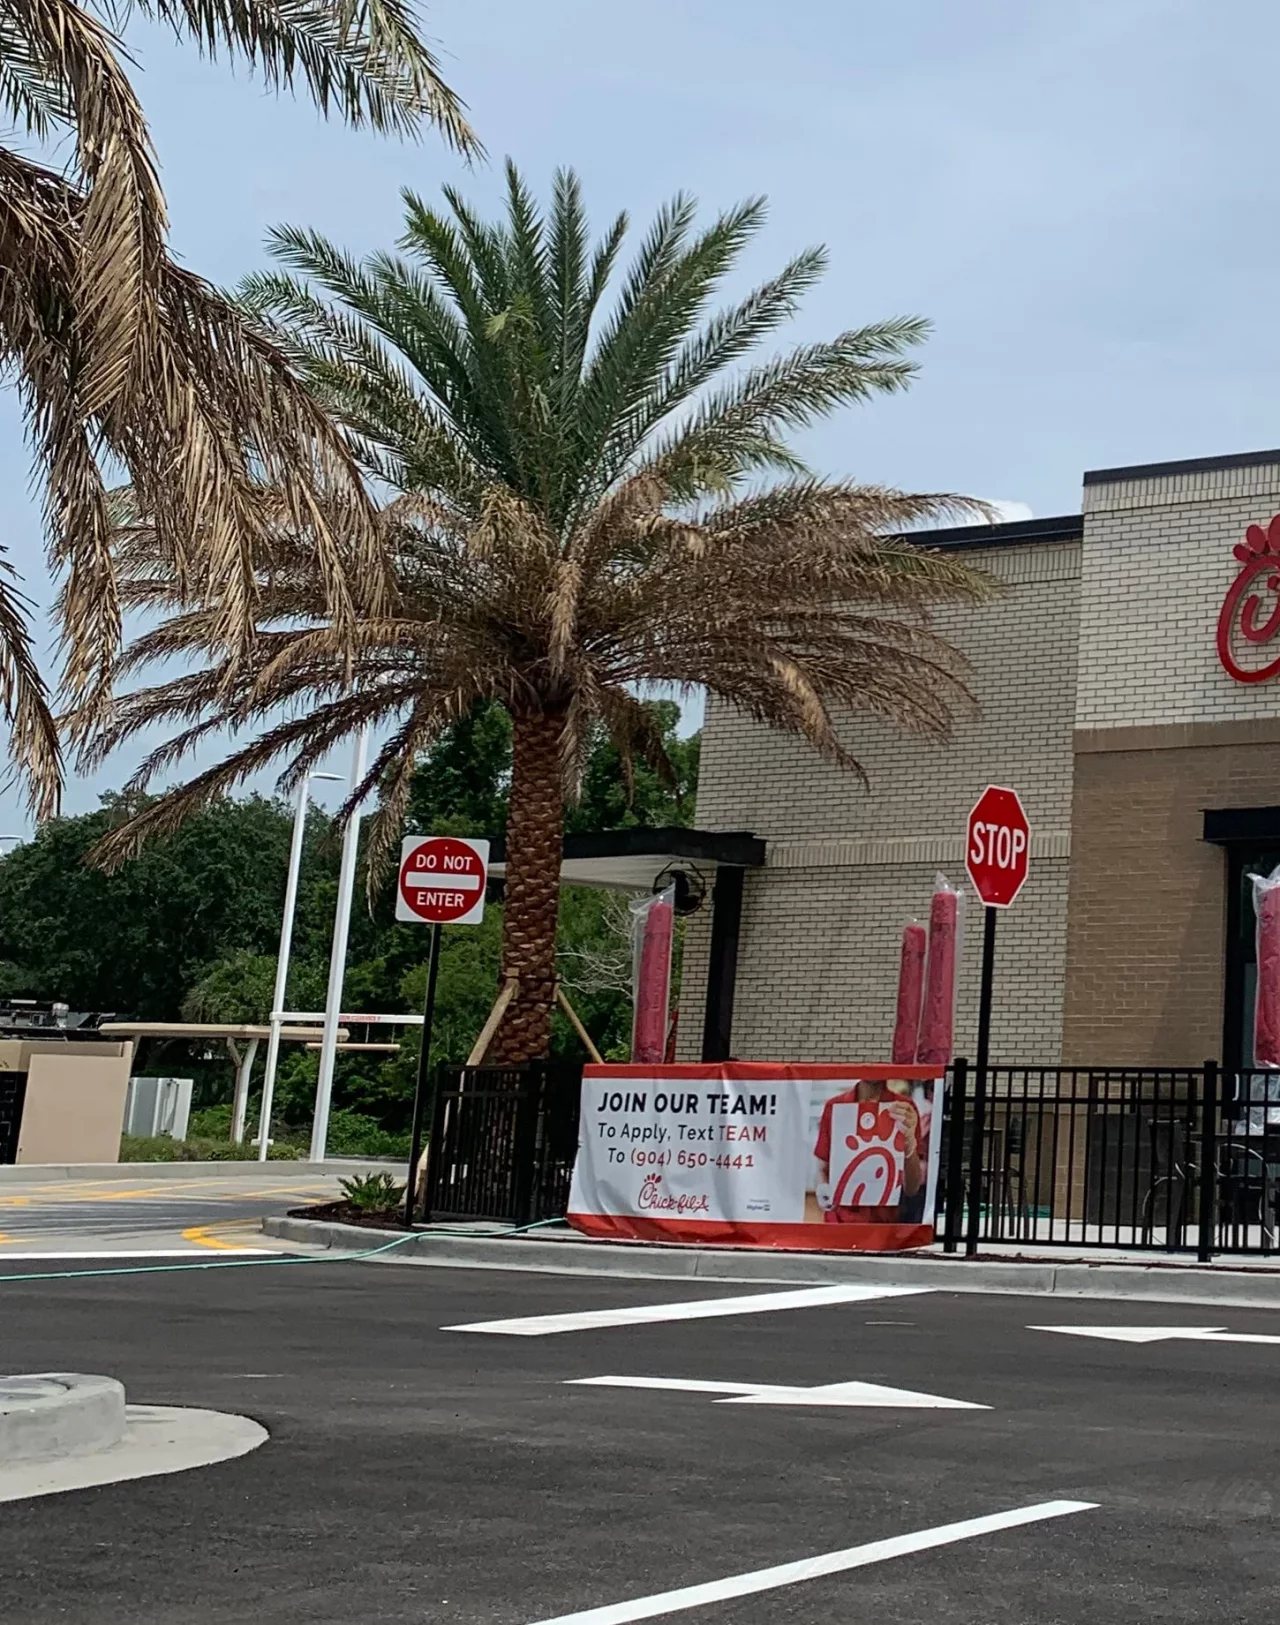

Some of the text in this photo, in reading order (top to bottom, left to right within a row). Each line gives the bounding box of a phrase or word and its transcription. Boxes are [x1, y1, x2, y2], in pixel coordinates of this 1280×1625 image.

[970, 820, 1026, 871] STOP
[415, 853, 474, 871] DO NOT
[416, 891, 465, 908] ENTER
[597, 1092, 777, 1115] JOIN OUR TEAM!
[597, 1122, 767, 1144] To Apply, Text TEAM
[608, 1147, 754, 1169] To (904) 650-4441
[638, 1173, 709, 1214] Chick-fil-A
